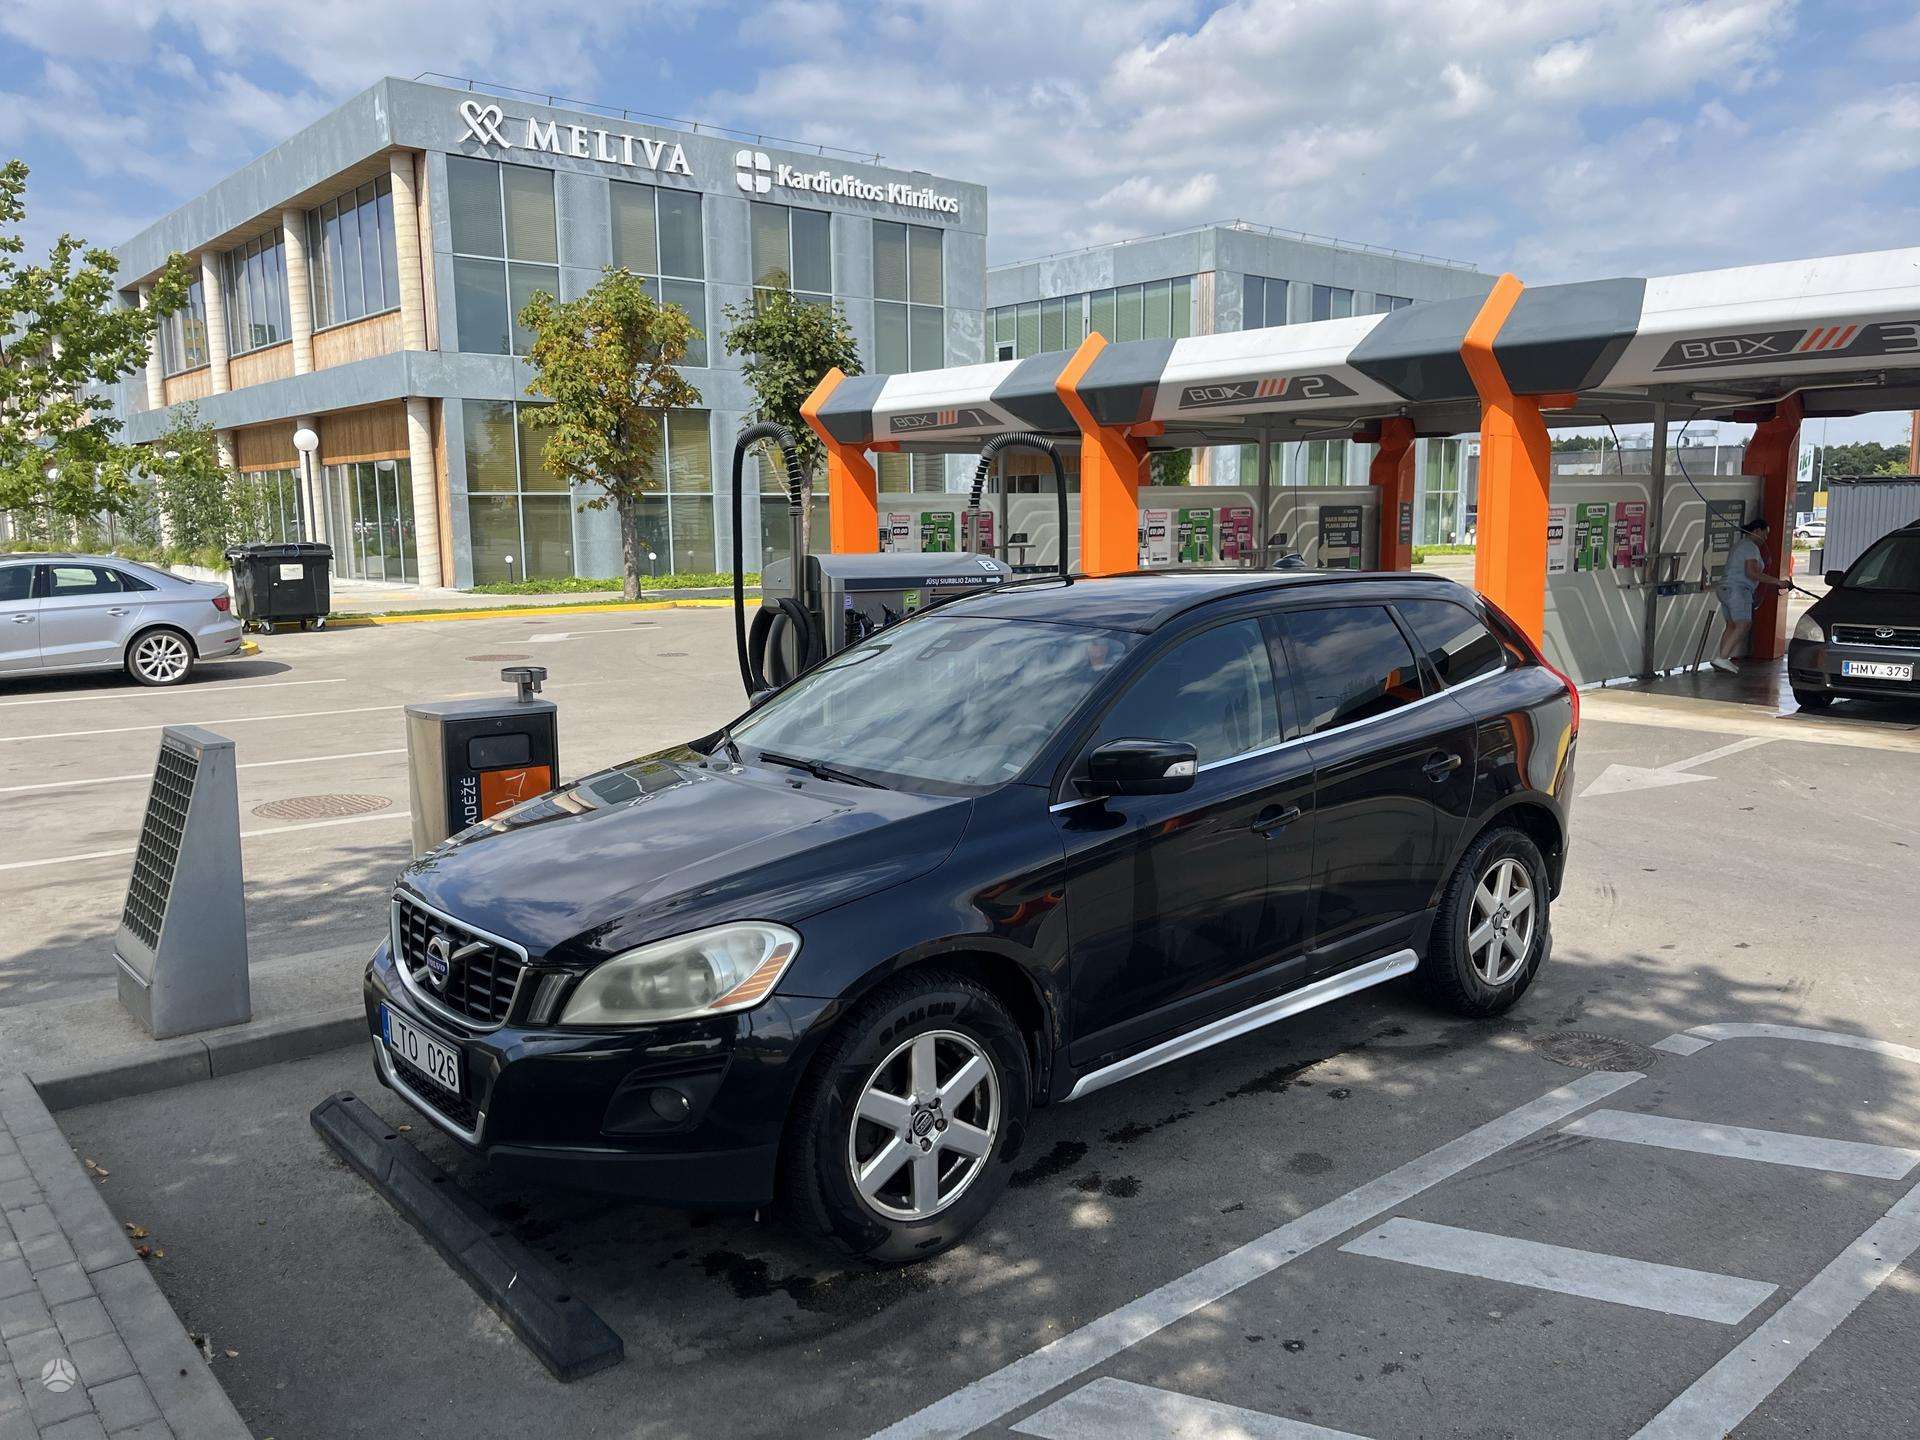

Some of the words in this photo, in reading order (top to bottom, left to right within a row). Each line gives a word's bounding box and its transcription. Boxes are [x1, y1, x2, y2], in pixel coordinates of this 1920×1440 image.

[524, 116, 694, 177] MELIVA
[776, 162, 886, 203] Kardiolitos
[887, 181, 960, 215] Klinikos
[1680, 336, 1780, 359] BOX
[1879, 323, 1920, 353] 3
[1188, 385, 1247, 401] BOX
[1299, 376, 1330, 398] 2
[893, 415, 932, 427] BOX
[1799, 450, 1812, 472] iki
[1849, 663, 1878, 676] HMV
[1886, 666, 1911, 678] 379
[389, 1014, 419, 1062] LTO
[427, 1042, 457, 1087] 026
